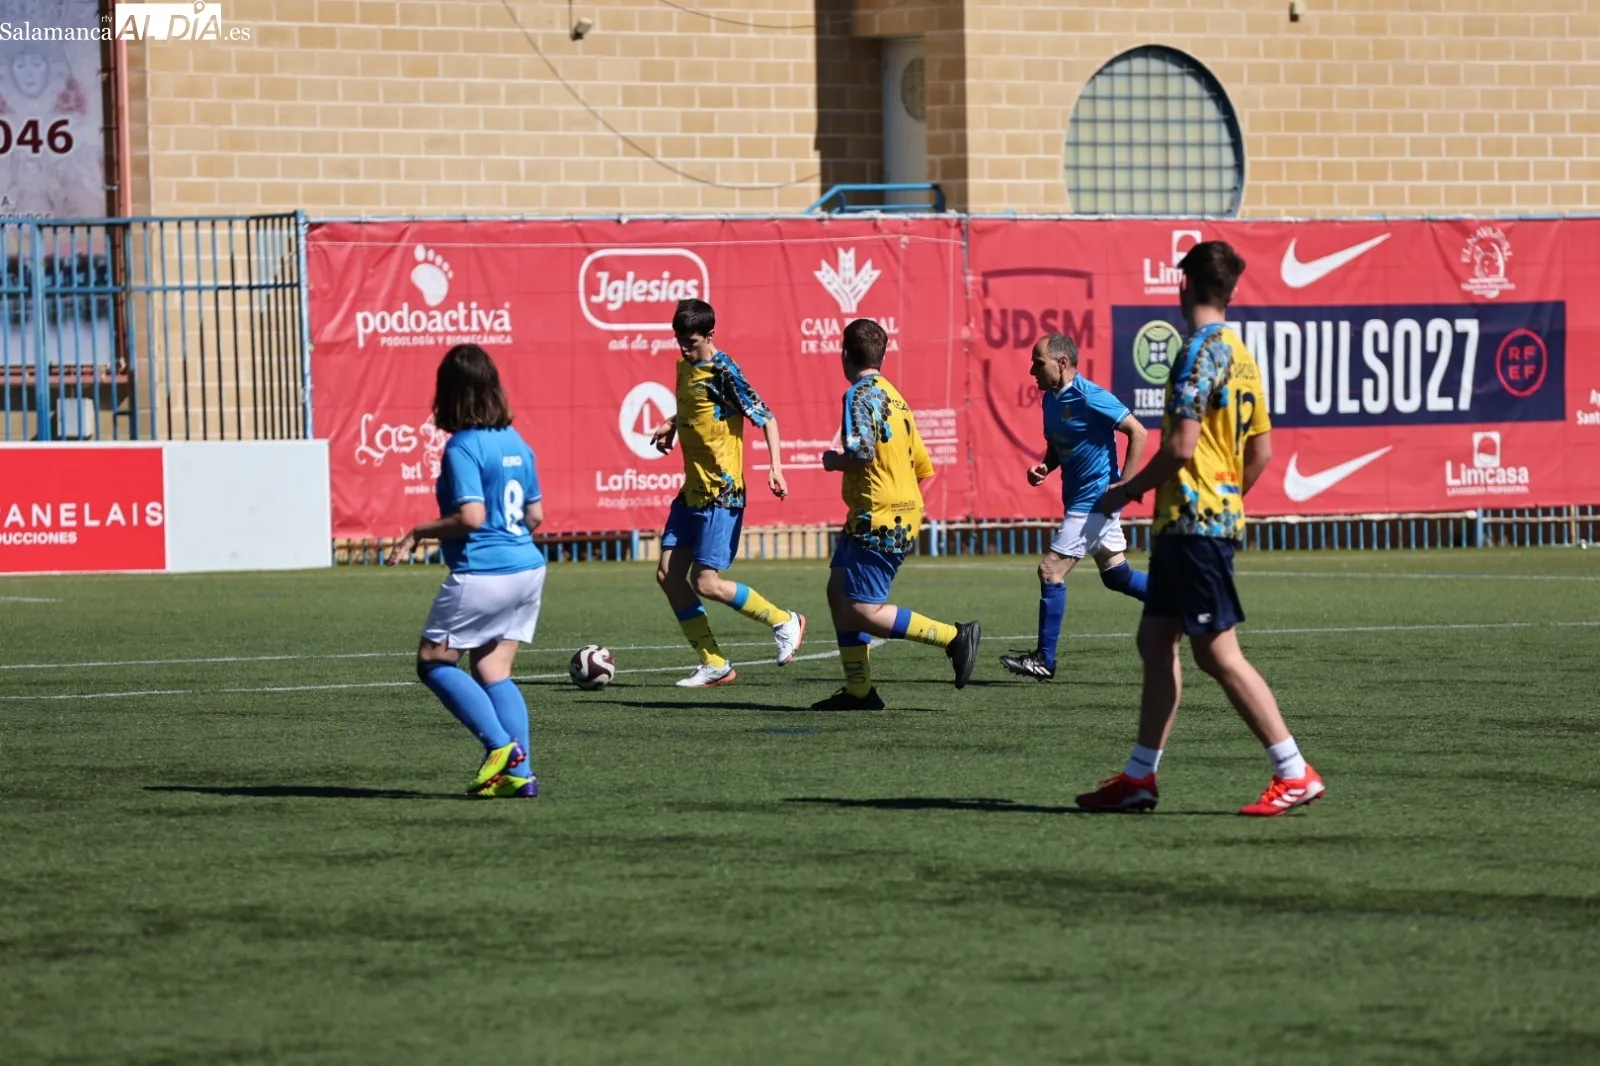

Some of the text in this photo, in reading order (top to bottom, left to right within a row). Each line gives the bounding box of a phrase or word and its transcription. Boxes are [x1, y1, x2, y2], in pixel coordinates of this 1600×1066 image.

[1143, 257, 1184, 286] Lim
[356, 302, 512, 348] podoactiva
[800, 318, 841, 341] CAJA
[983, 308, 1095, 350] UDSM
[1223, 318, 1480, 415] MPULSO27
[1508, 346, 1536, 361] RF
[1508, 365, 1536, 380] EF
[1015, 382, 1041, 409] 19
[355, 412, 418, 467] Las
[1445, 459, 1530, 486] Limcasa
[2, 501, 164, 529] ANELAIS
